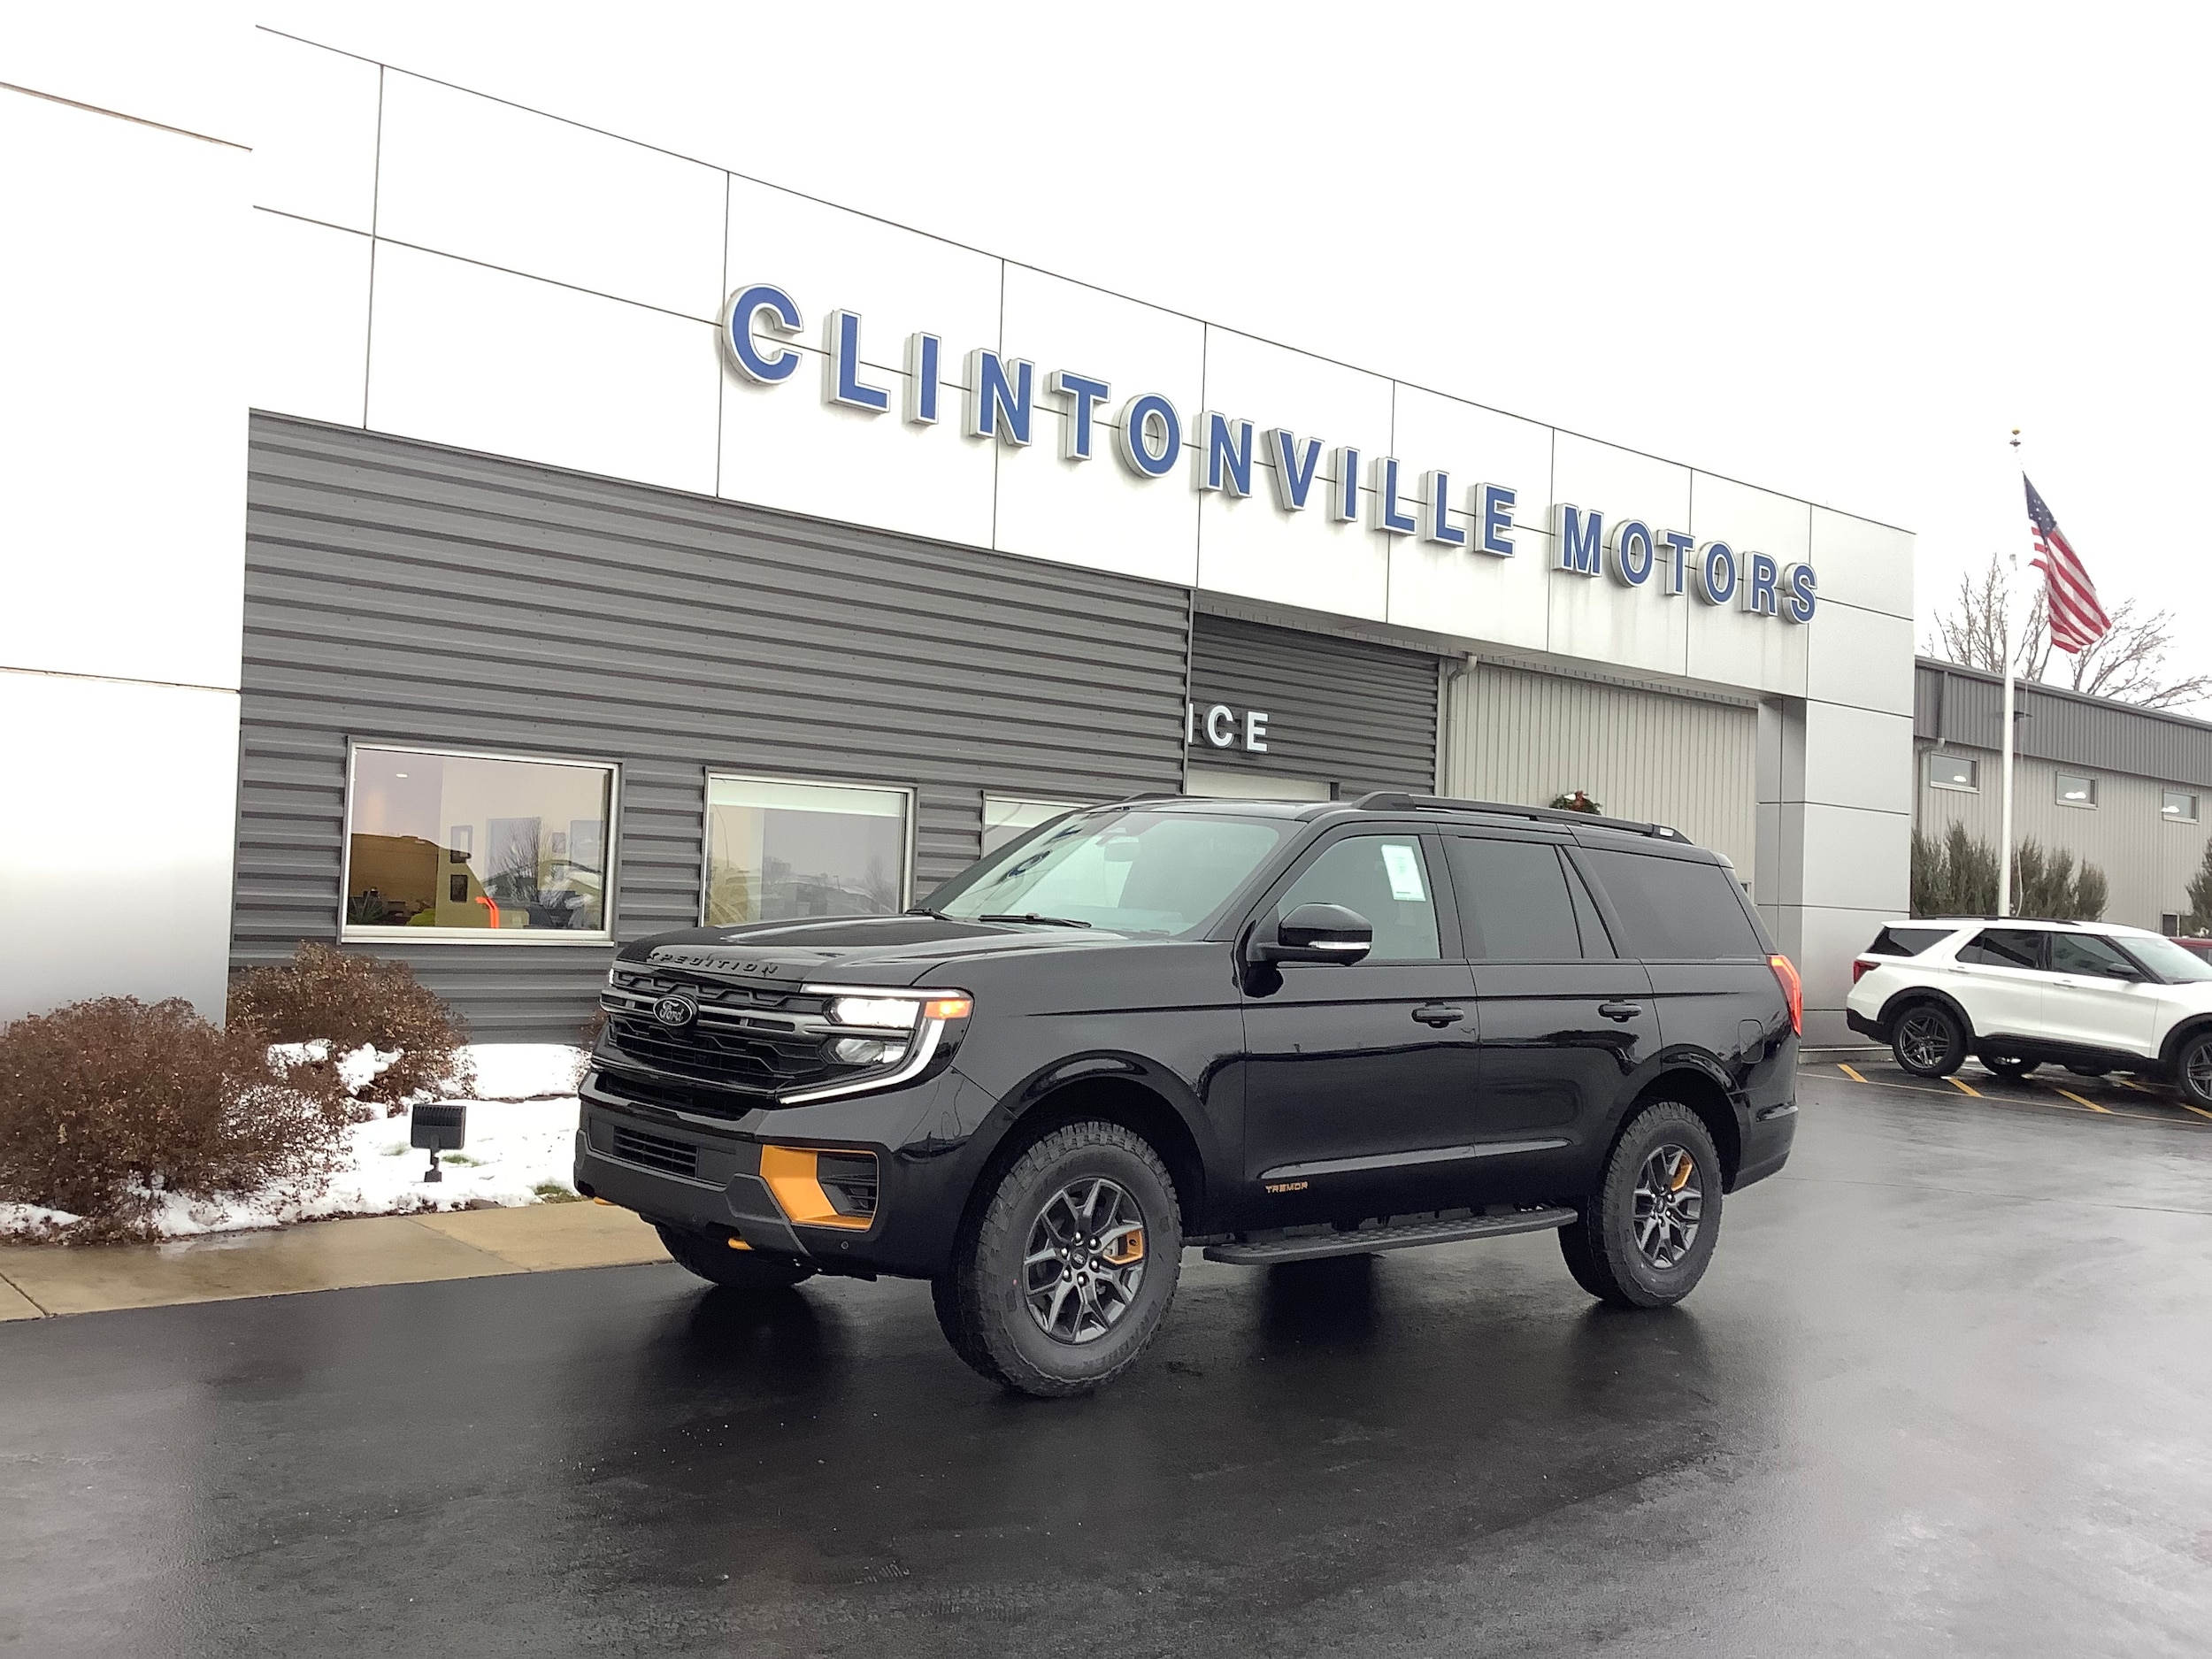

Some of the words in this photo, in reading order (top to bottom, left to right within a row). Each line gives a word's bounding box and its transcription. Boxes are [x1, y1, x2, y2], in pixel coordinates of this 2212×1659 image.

[722, 282, 1517, 559] CLINTONVILLE
[1553, 502, 1818, 625] MOTORS
[1188, 702, 1269, 753] ICE
[657, 999, 687, 1024] Ford
[1263, 1181, 1309, 1194] TREMOR
